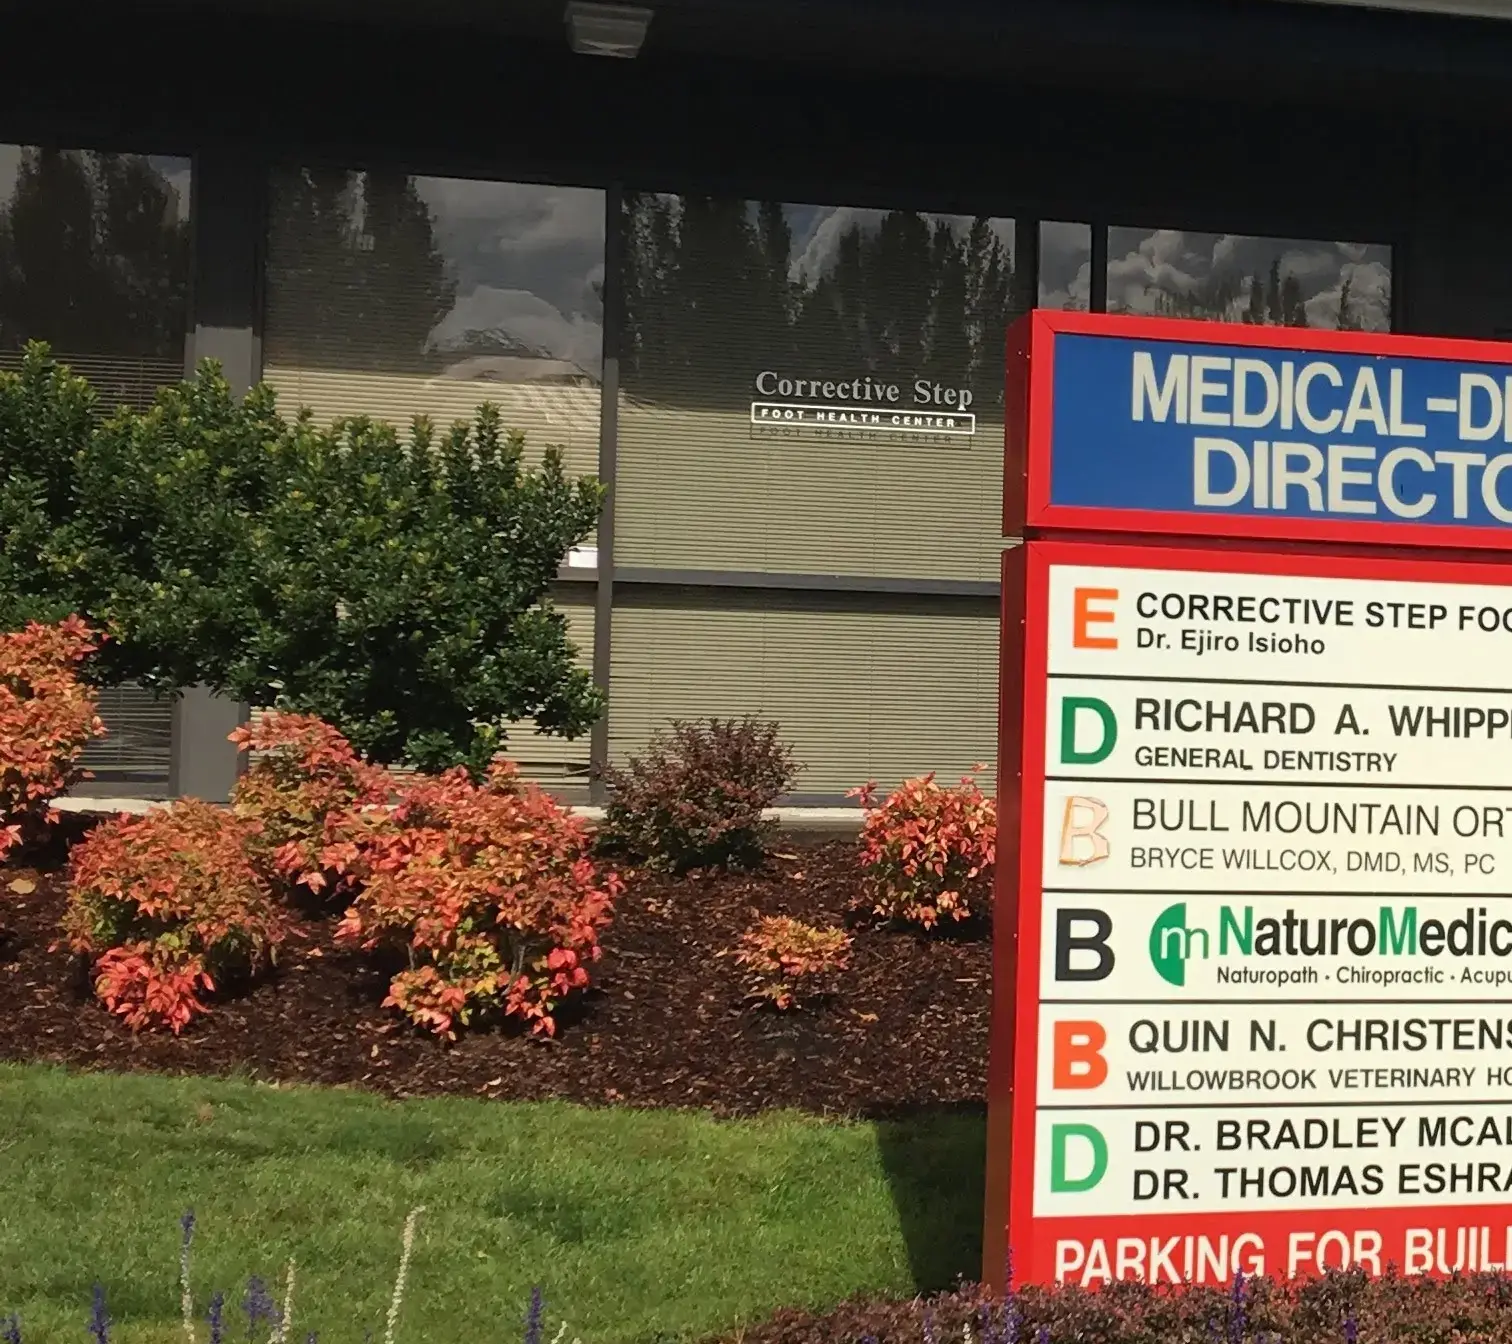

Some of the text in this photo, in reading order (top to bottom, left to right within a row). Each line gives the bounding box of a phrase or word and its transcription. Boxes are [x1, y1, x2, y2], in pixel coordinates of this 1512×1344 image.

[755, 371, 973, 410] Corrective Step
[761, 409, 955, 428] FOOT HEALTH CENTER
[1073, 588, 1118, 649] E
[1137, 592, 1353, 627] CORRECTIVE
[1366, 602, 1447, 629] STEP
[1138, 628, 1324, 655] Dr. Ejiro Isioho
[1061, 697, 1117, 764] D
[1136, 698, 1315, 734] RICHARD
[1335, 704, 1368, 735] A.
[1135, 746, 1397, 772] GENERAL DENTISTRY
[1059, 796, 1110, 867] B
[1134, 799, 1229, 831] BULL
[1243, 801, 1438, 835] MOUNTAIN
[1131, 847, 1494, 875] BRYCE WILLCOX, DMD, MS, PC
[1055, 908, 1115, 981] B
[1218, 967, 1317, 987] Naturopath
[1337, 966, 1443, 987] Chiropractic
[1129, 1020, 1228, 1053] QUIN
[1250, 1020, 1285, 1051] N.
[1053, 1021, 1108, 1089] B
[1127, 1070, 1316, 1090] WILLOWBROOK
[1329, 1068, 1475, 1088] VETERINARY
[1135, 1121, 1200, 1151] DR.
[1217, 1117, 1405, 1150] BRADLEY
[1051, 1124, 1108, 1192] D
[1134, 1169, 1198, 1200] DR.
[1214, 1165, 1383, 1198] THOMAS
[1055, 1234, 1264, 1287] PARKING
[1288, 1230, 1383, 1277] FOR
